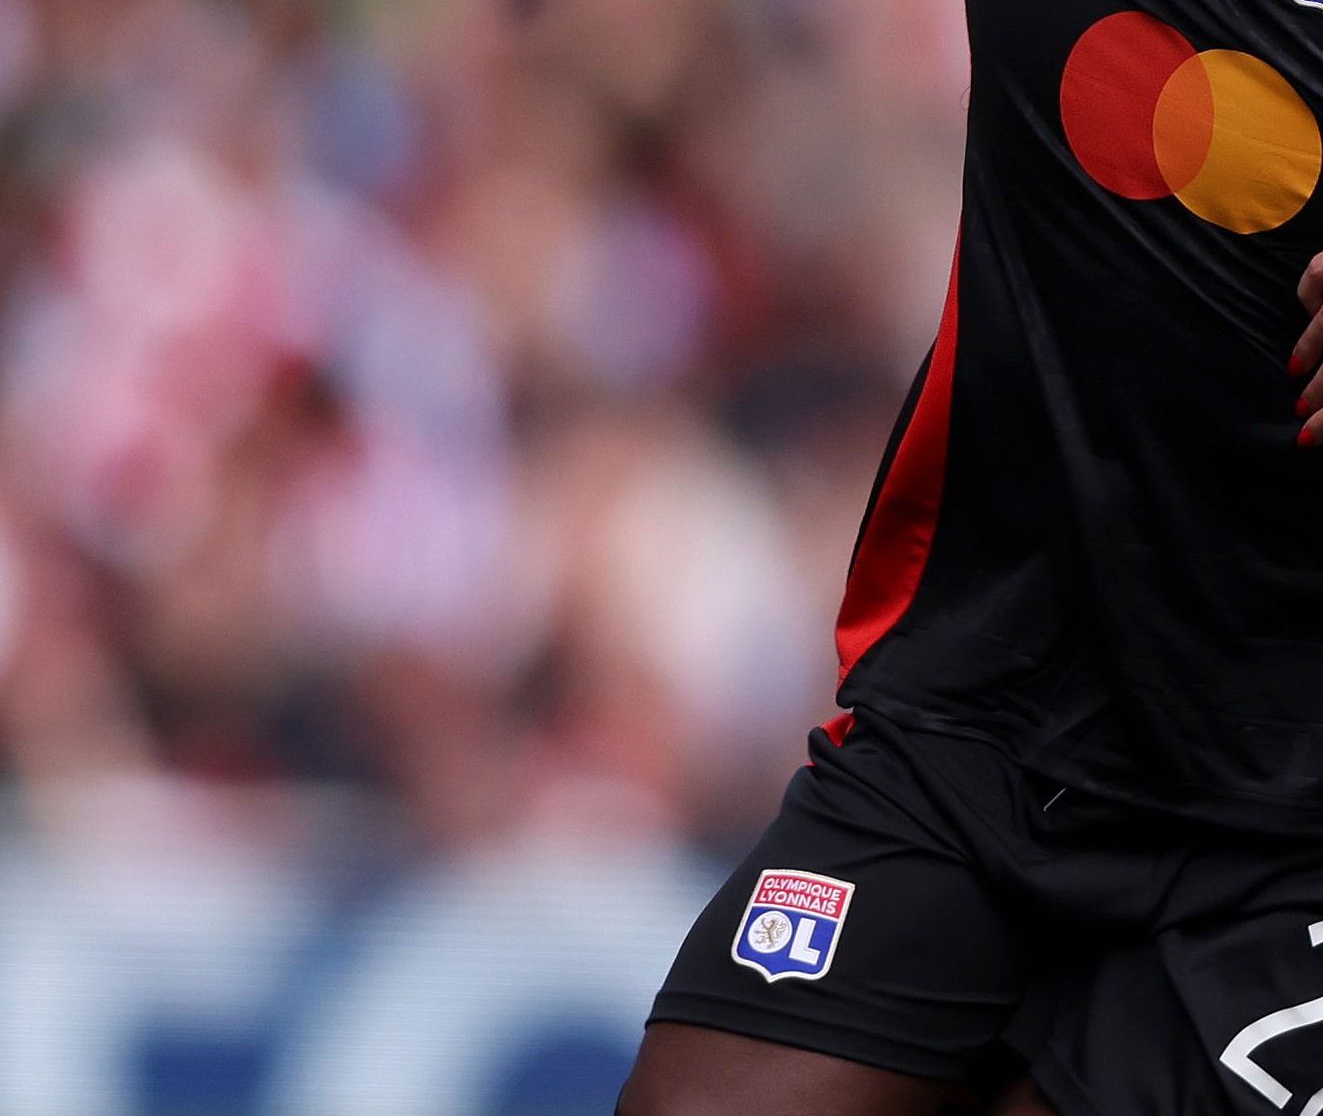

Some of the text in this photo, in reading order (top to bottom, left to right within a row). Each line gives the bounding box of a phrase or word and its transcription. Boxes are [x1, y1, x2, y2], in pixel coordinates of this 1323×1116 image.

[763, 877, 842, 901] OLYMPIQUE
[759, 890, 837, 914] LYONNAIS
[747, 910, 821, 966] OL
